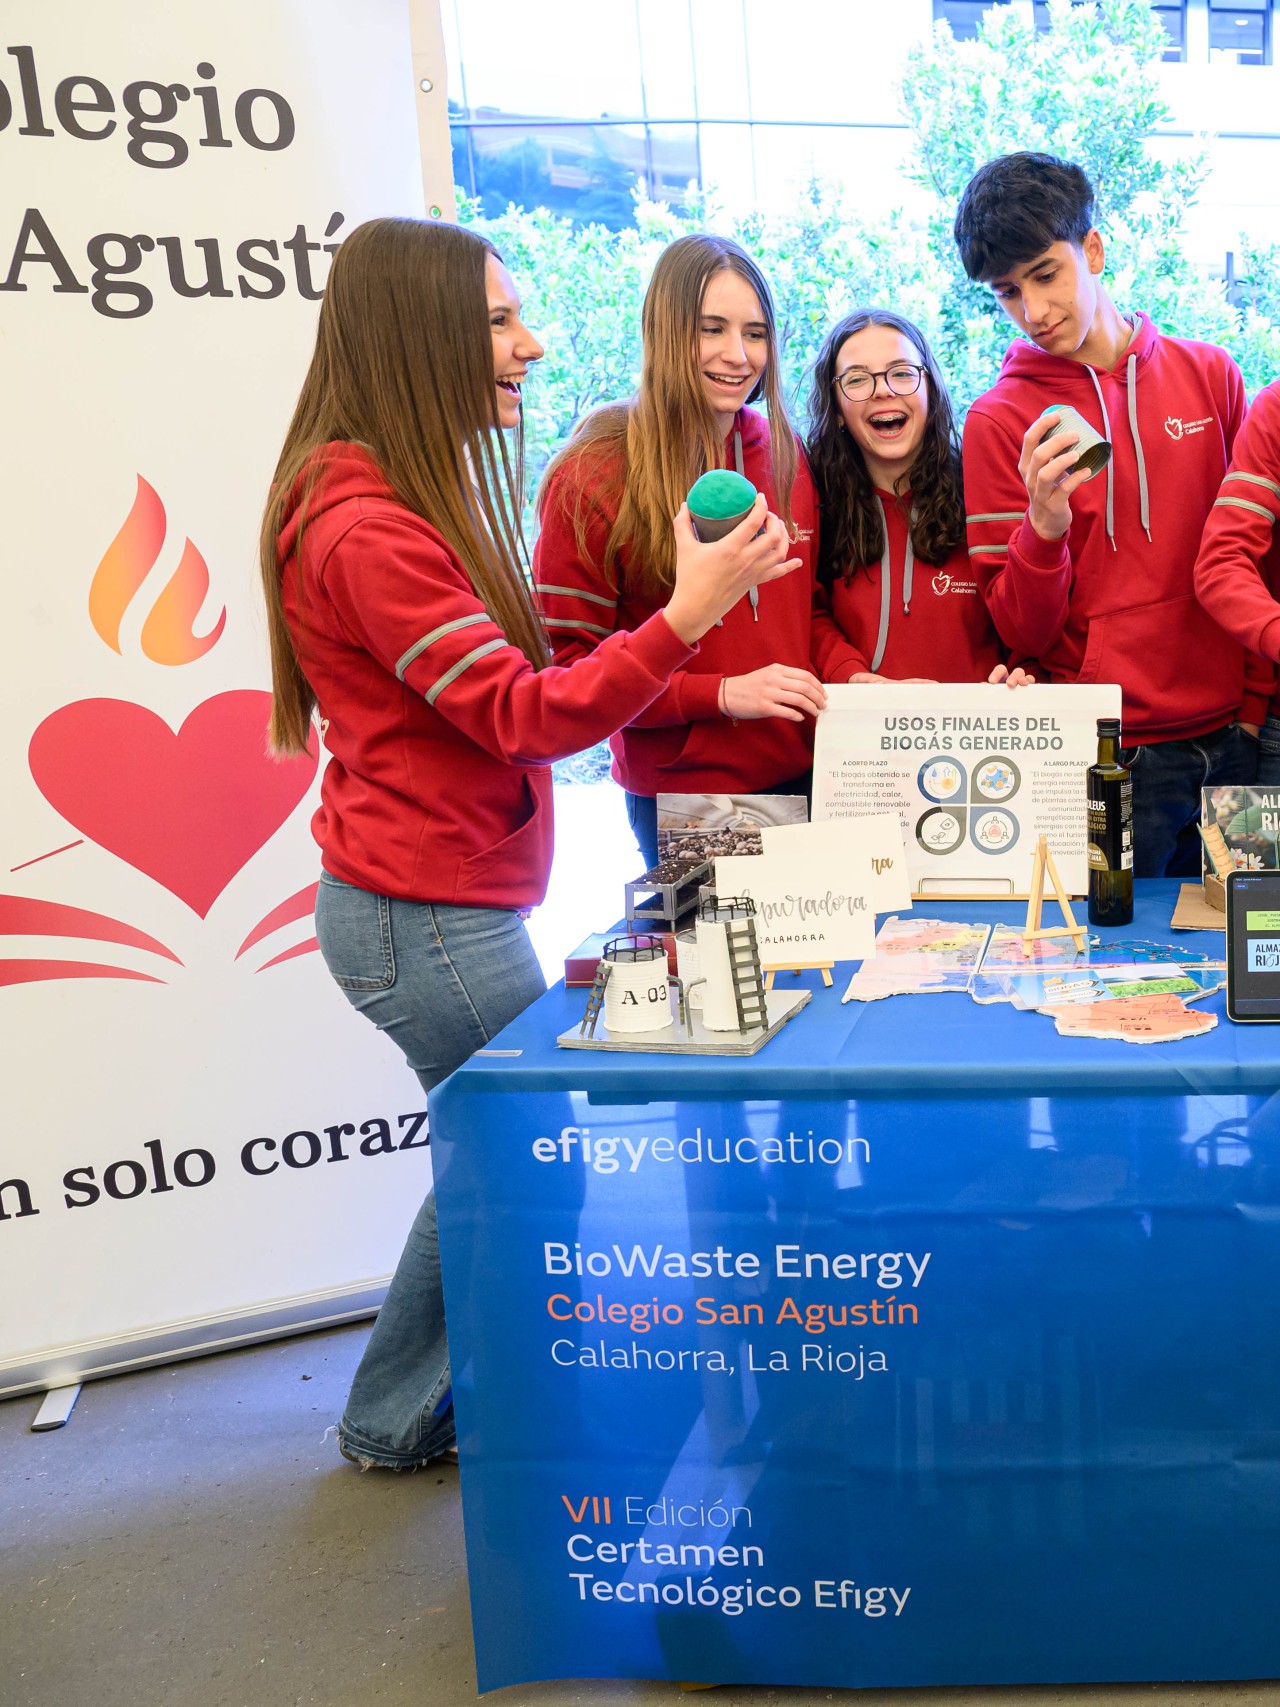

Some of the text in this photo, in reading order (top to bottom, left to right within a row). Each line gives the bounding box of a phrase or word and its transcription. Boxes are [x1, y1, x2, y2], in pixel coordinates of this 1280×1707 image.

[0, 45, 296, 169] legio
[880, 732, 1064, 751] BIOGÁS GENERADO
[884, 717, 1061, 731] USOS FINALES DEL
[841, 770, 866, 779] biogás
[833, 790, 903, 798] electricidad, calor,
[1041, 797, 1067, 805] plantas
[741, 889, 868, 928] puradora
[621, 984, 667, 1006] A-03
[532, 1127, 871, 1174] efigyeducation
[62, 1138, 217, 1210] solo
[543, 1241, 932, 1289] BioWaste Energy
[547, 1293, 919, 1334] Colegio San Agustín
[551, 1338, 889, 1381] Calahorra, La Rioja
[561, 1495, 752, 1528] VII Edición
[567, 1533, 764, 1566] Certamen
[568, 1572, 912, 1618] Tecnológico Efigy
